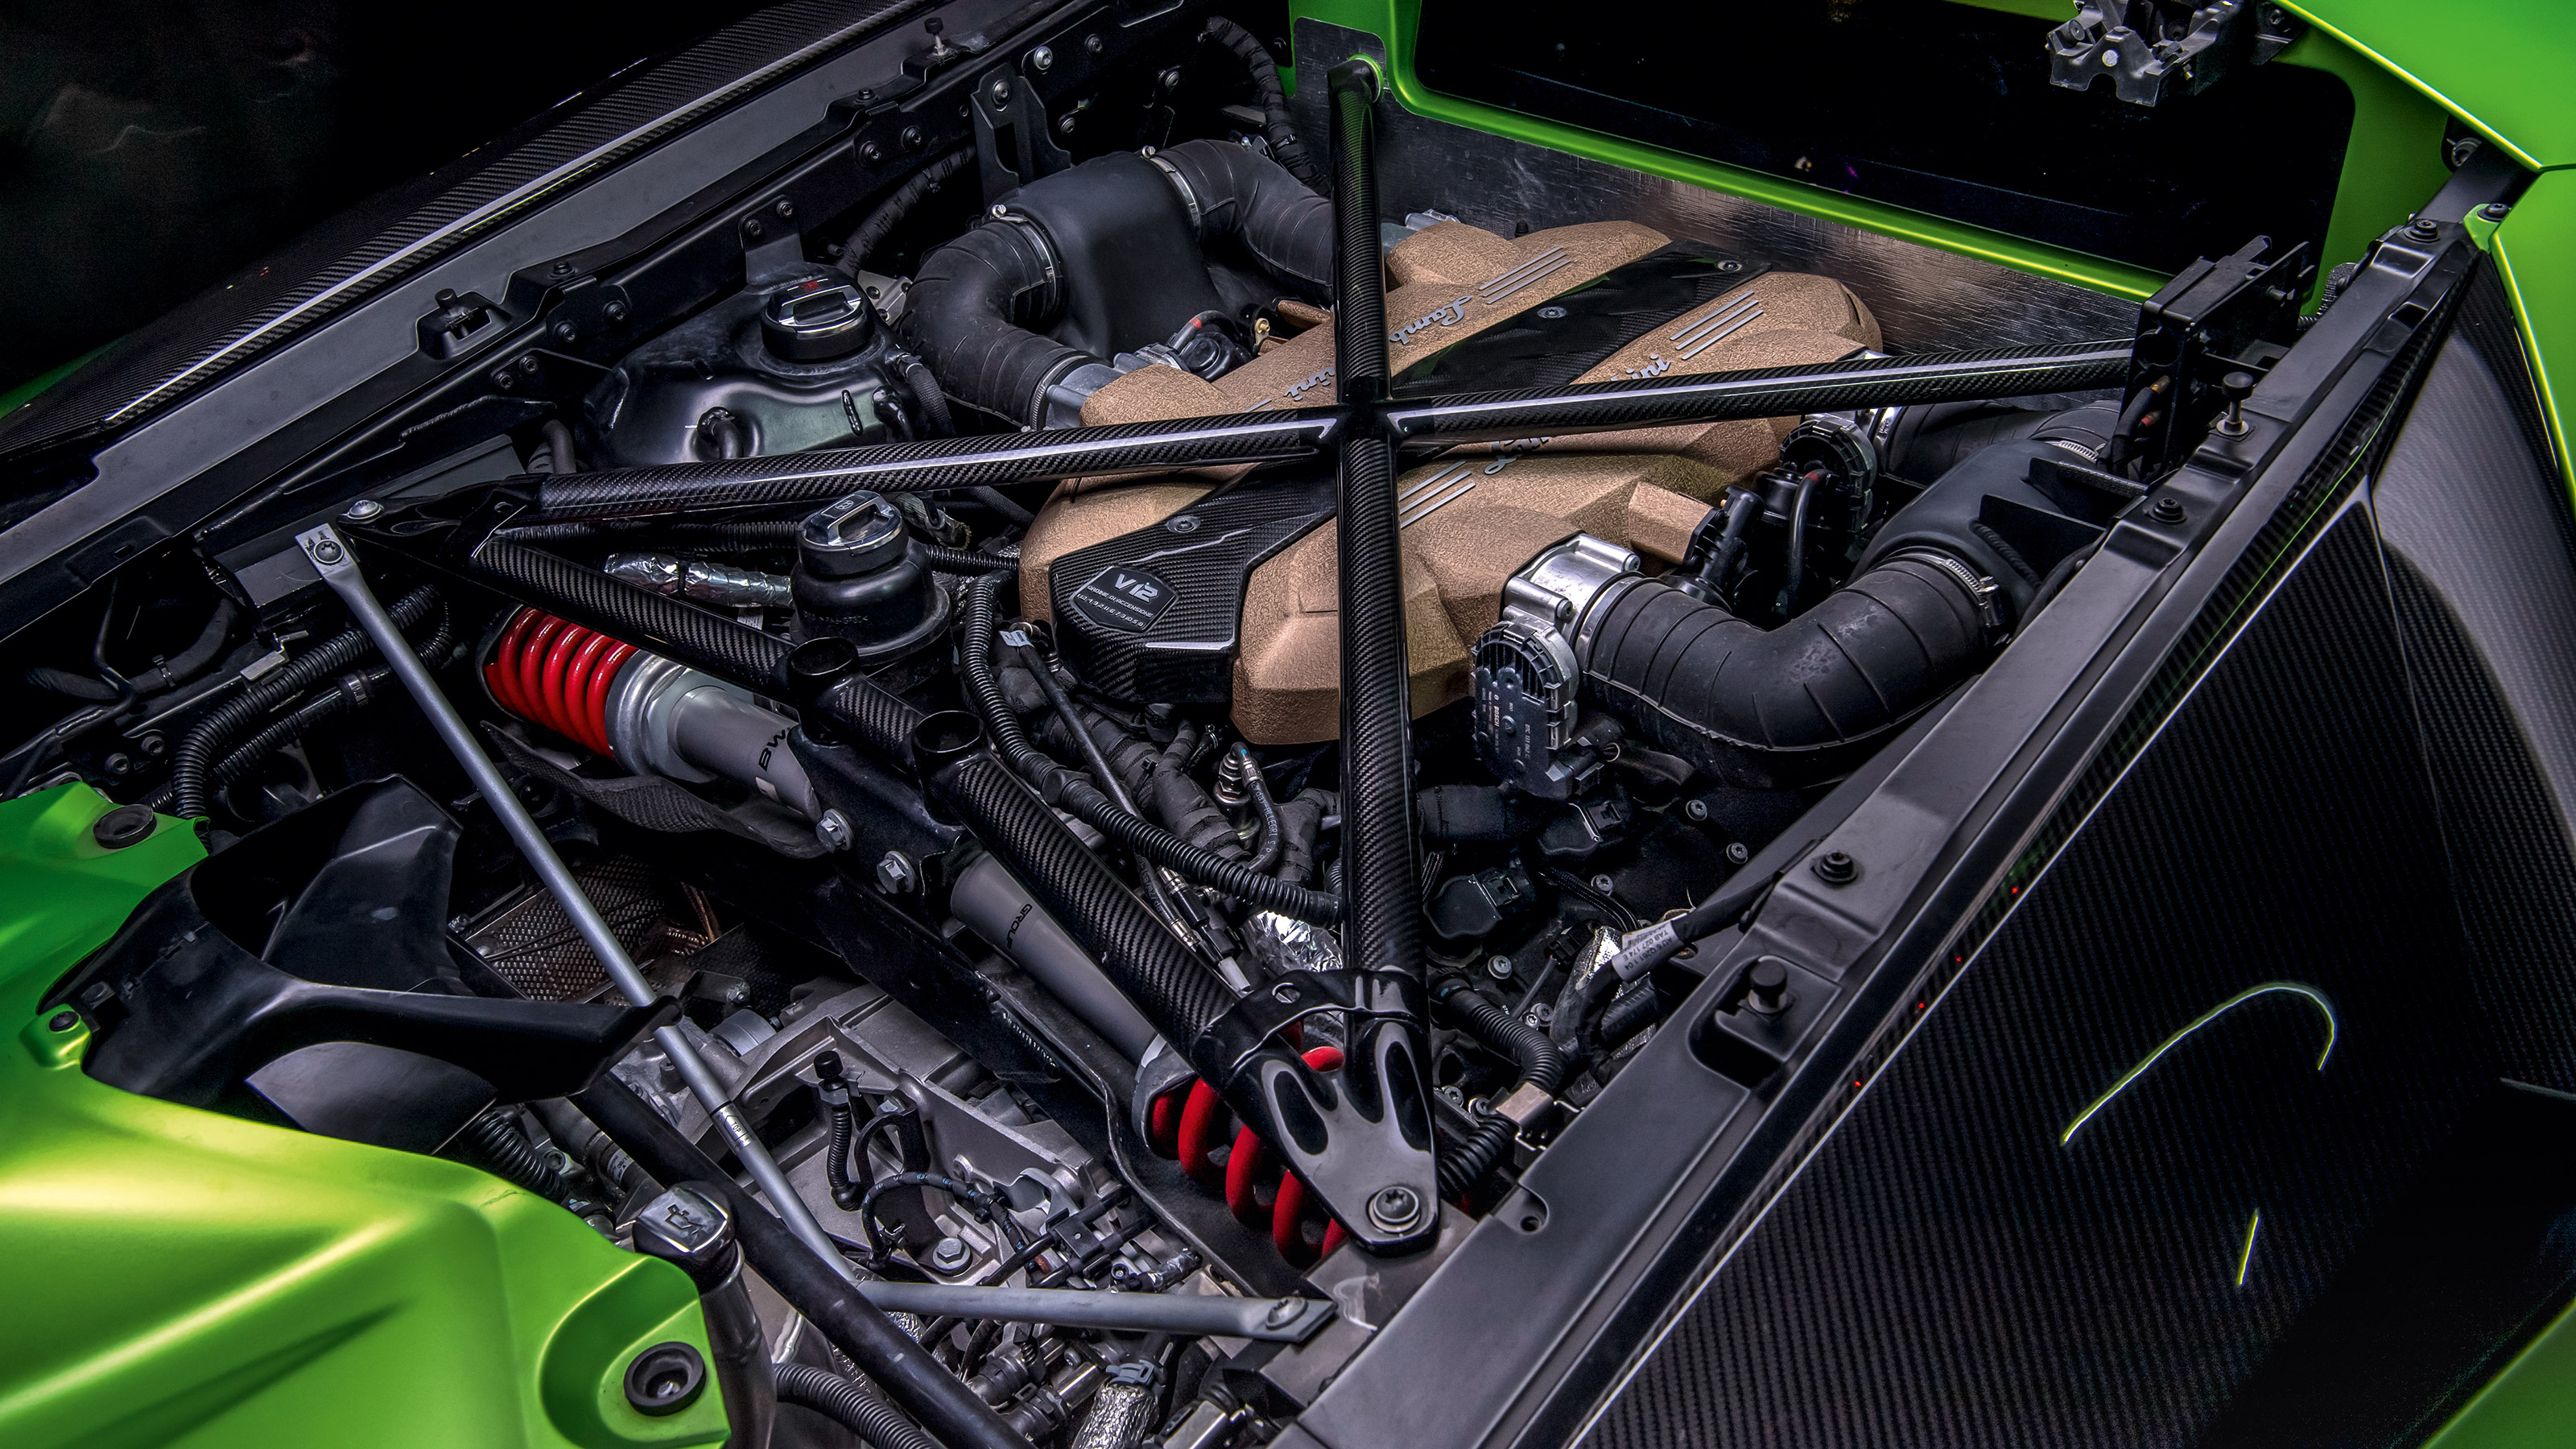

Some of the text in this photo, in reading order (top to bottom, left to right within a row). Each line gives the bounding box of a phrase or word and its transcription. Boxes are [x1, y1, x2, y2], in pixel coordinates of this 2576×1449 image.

[1114, 573, 1159, 603] V12
[1087, 585, 1109, 598] ORDINE
[1115, 598, 1154, 618] ACCENSIONE
[758, 728, 791, 773] BW
[1006, 903, 1033, 950] GROUP
[1654, 930, 1669, 941] TAB
[1643, 938, 1653, 950] 027
[1623, 954, 1629, 962] E
[1629, 947, 1641, 957] 174
[731, 1121, 741, 1133] TOP
